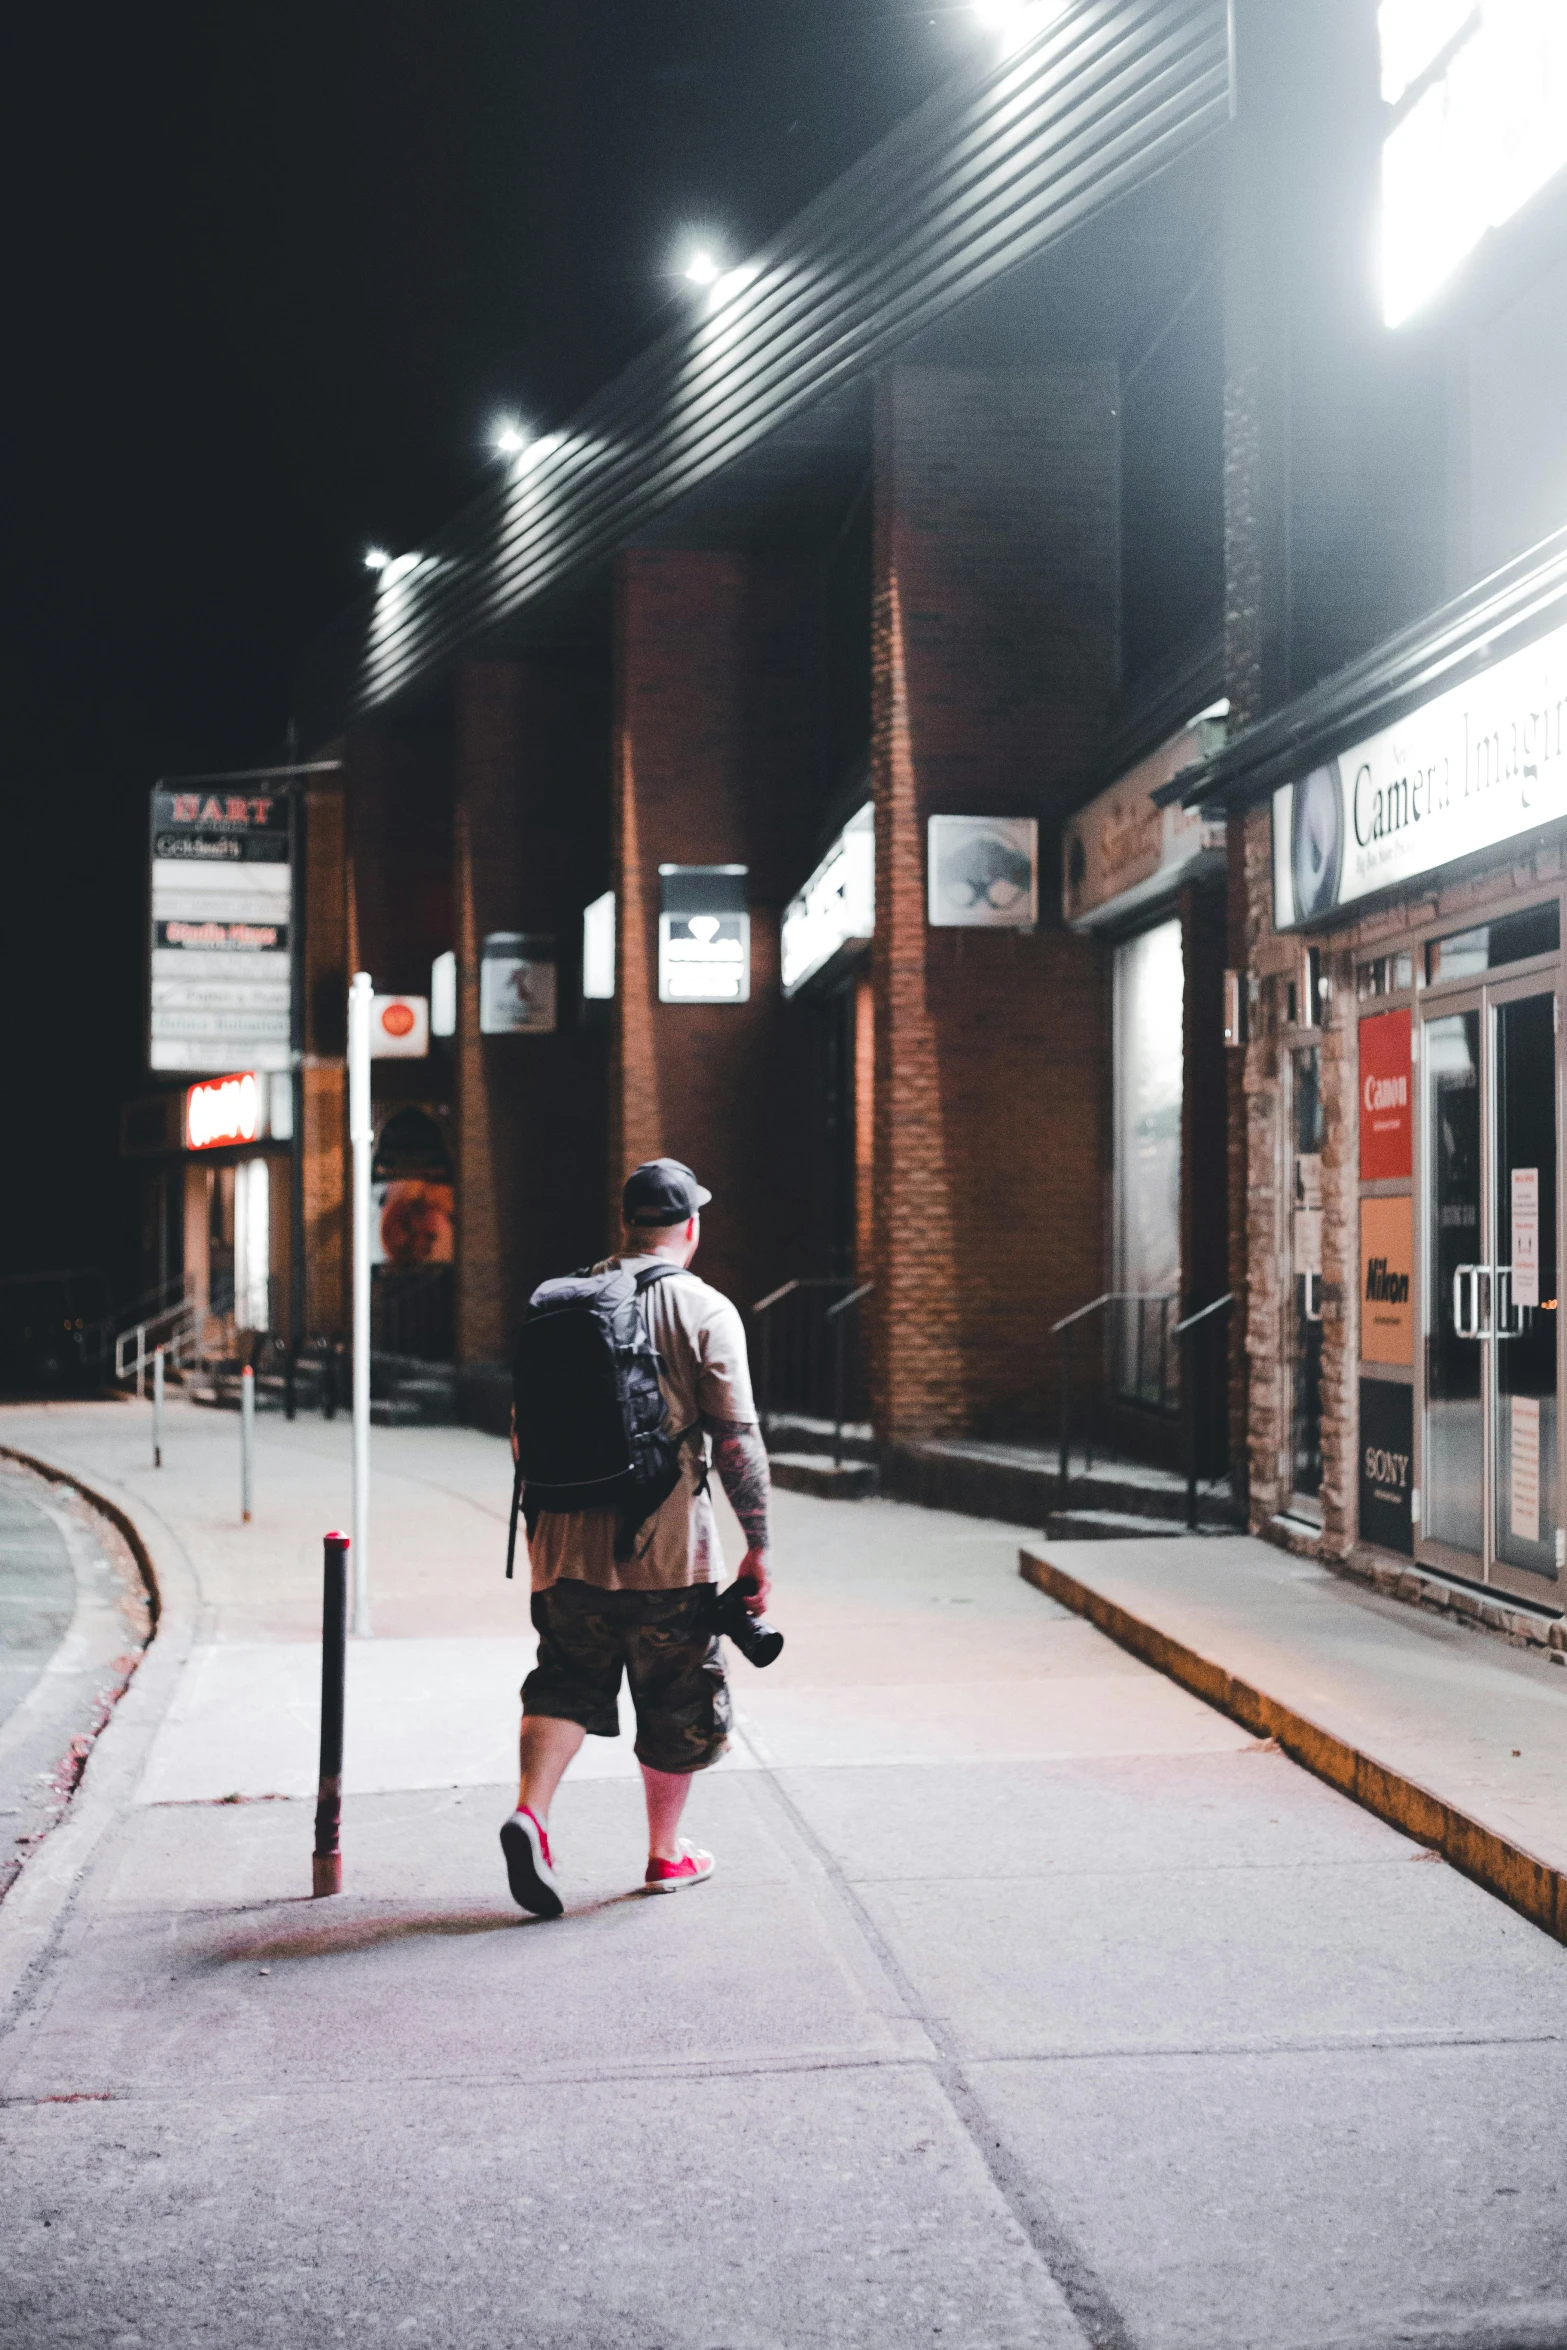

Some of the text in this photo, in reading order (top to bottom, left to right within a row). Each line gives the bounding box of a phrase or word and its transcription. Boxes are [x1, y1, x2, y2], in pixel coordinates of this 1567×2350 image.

[1354, 757, 1450, 847] Camera
[1364, 1075, 1407, 1111] Canon
[1366, 1257, 1408, 1304] Nikon
[1365, 1447, 1409, 1487] SONY
